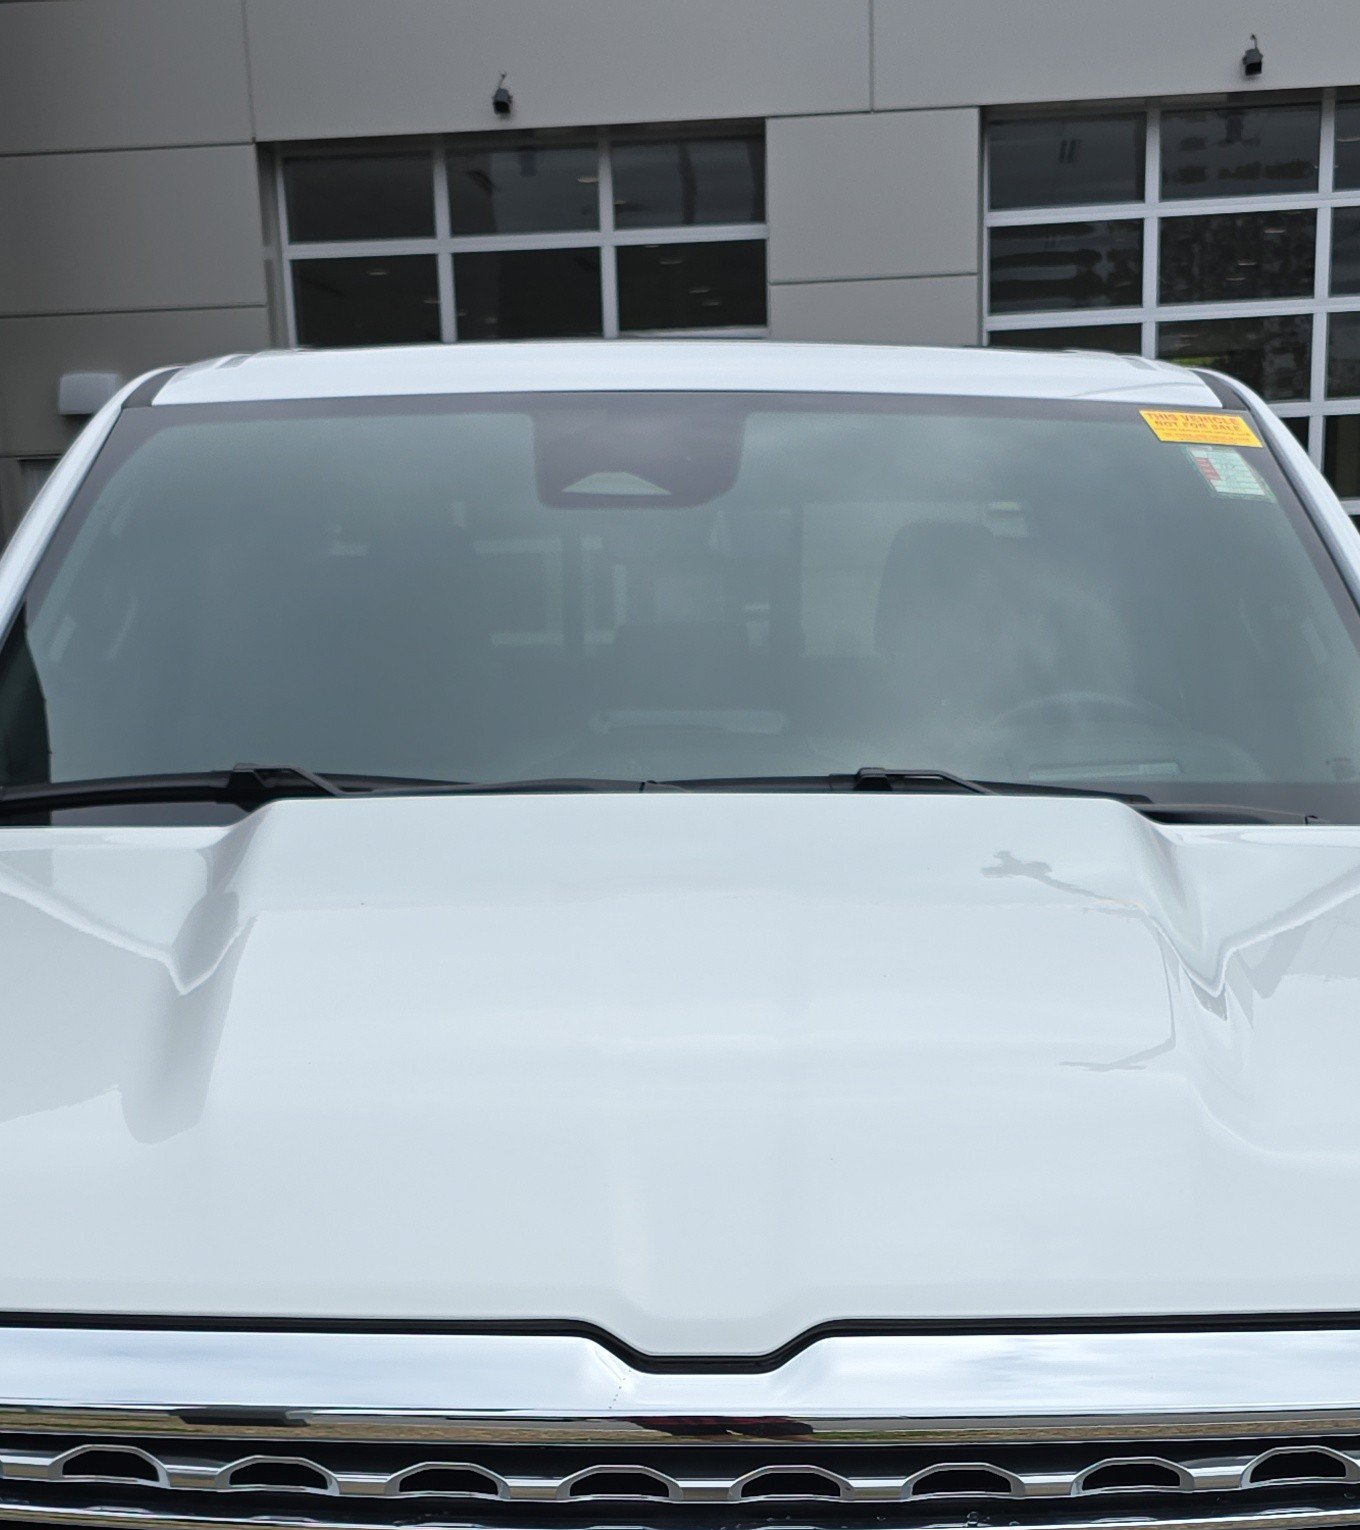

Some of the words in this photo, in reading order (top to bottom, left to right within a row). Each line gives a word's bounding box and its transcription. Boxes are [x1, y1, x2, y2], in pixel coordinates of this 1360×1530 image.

[1180, 414, 1240, 424] VEHICLE
[1154, 420, 1179, 428] NOT
[1182, 421, 1208, 430] FOR
[1210, 423, 1241, 432] SALE
